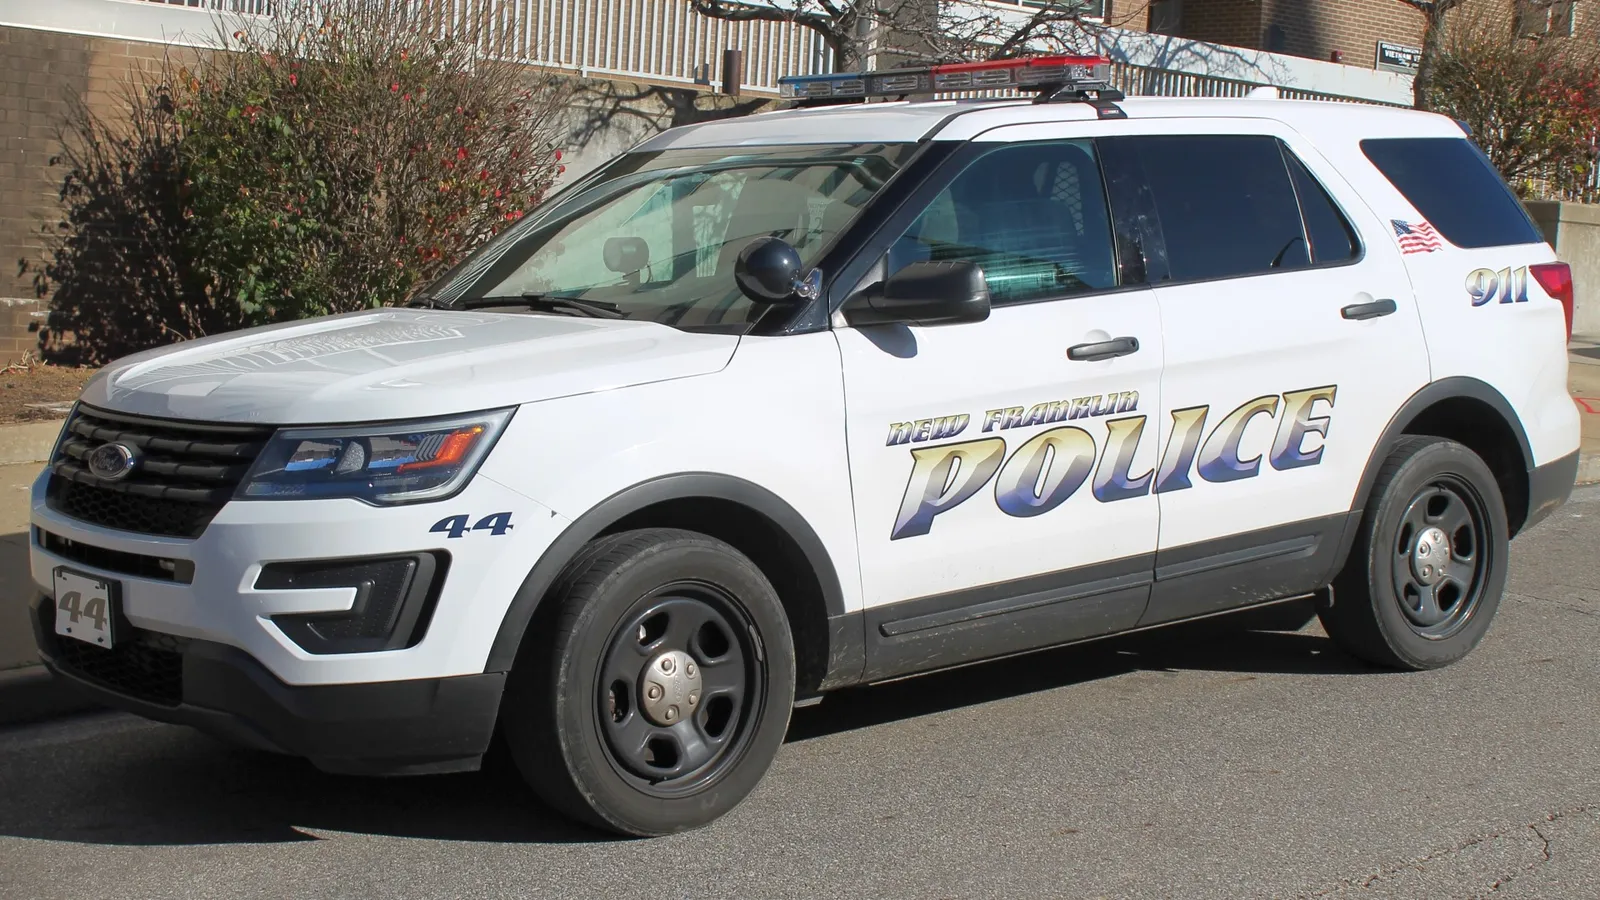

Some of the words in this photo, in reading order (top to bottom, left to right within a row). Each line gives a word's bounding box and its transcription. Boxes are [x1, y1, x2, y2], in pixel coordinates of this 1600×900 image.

[1465, 265, 1528, 307] 911
[886, 414, 970, 446] NEW
[982, 391, 1139, 432] FRANKLIN
[890, 384, 1337, 540] POLICE
[429, 512, 513, 538] 44
[58, 591, 107, 631] 44
